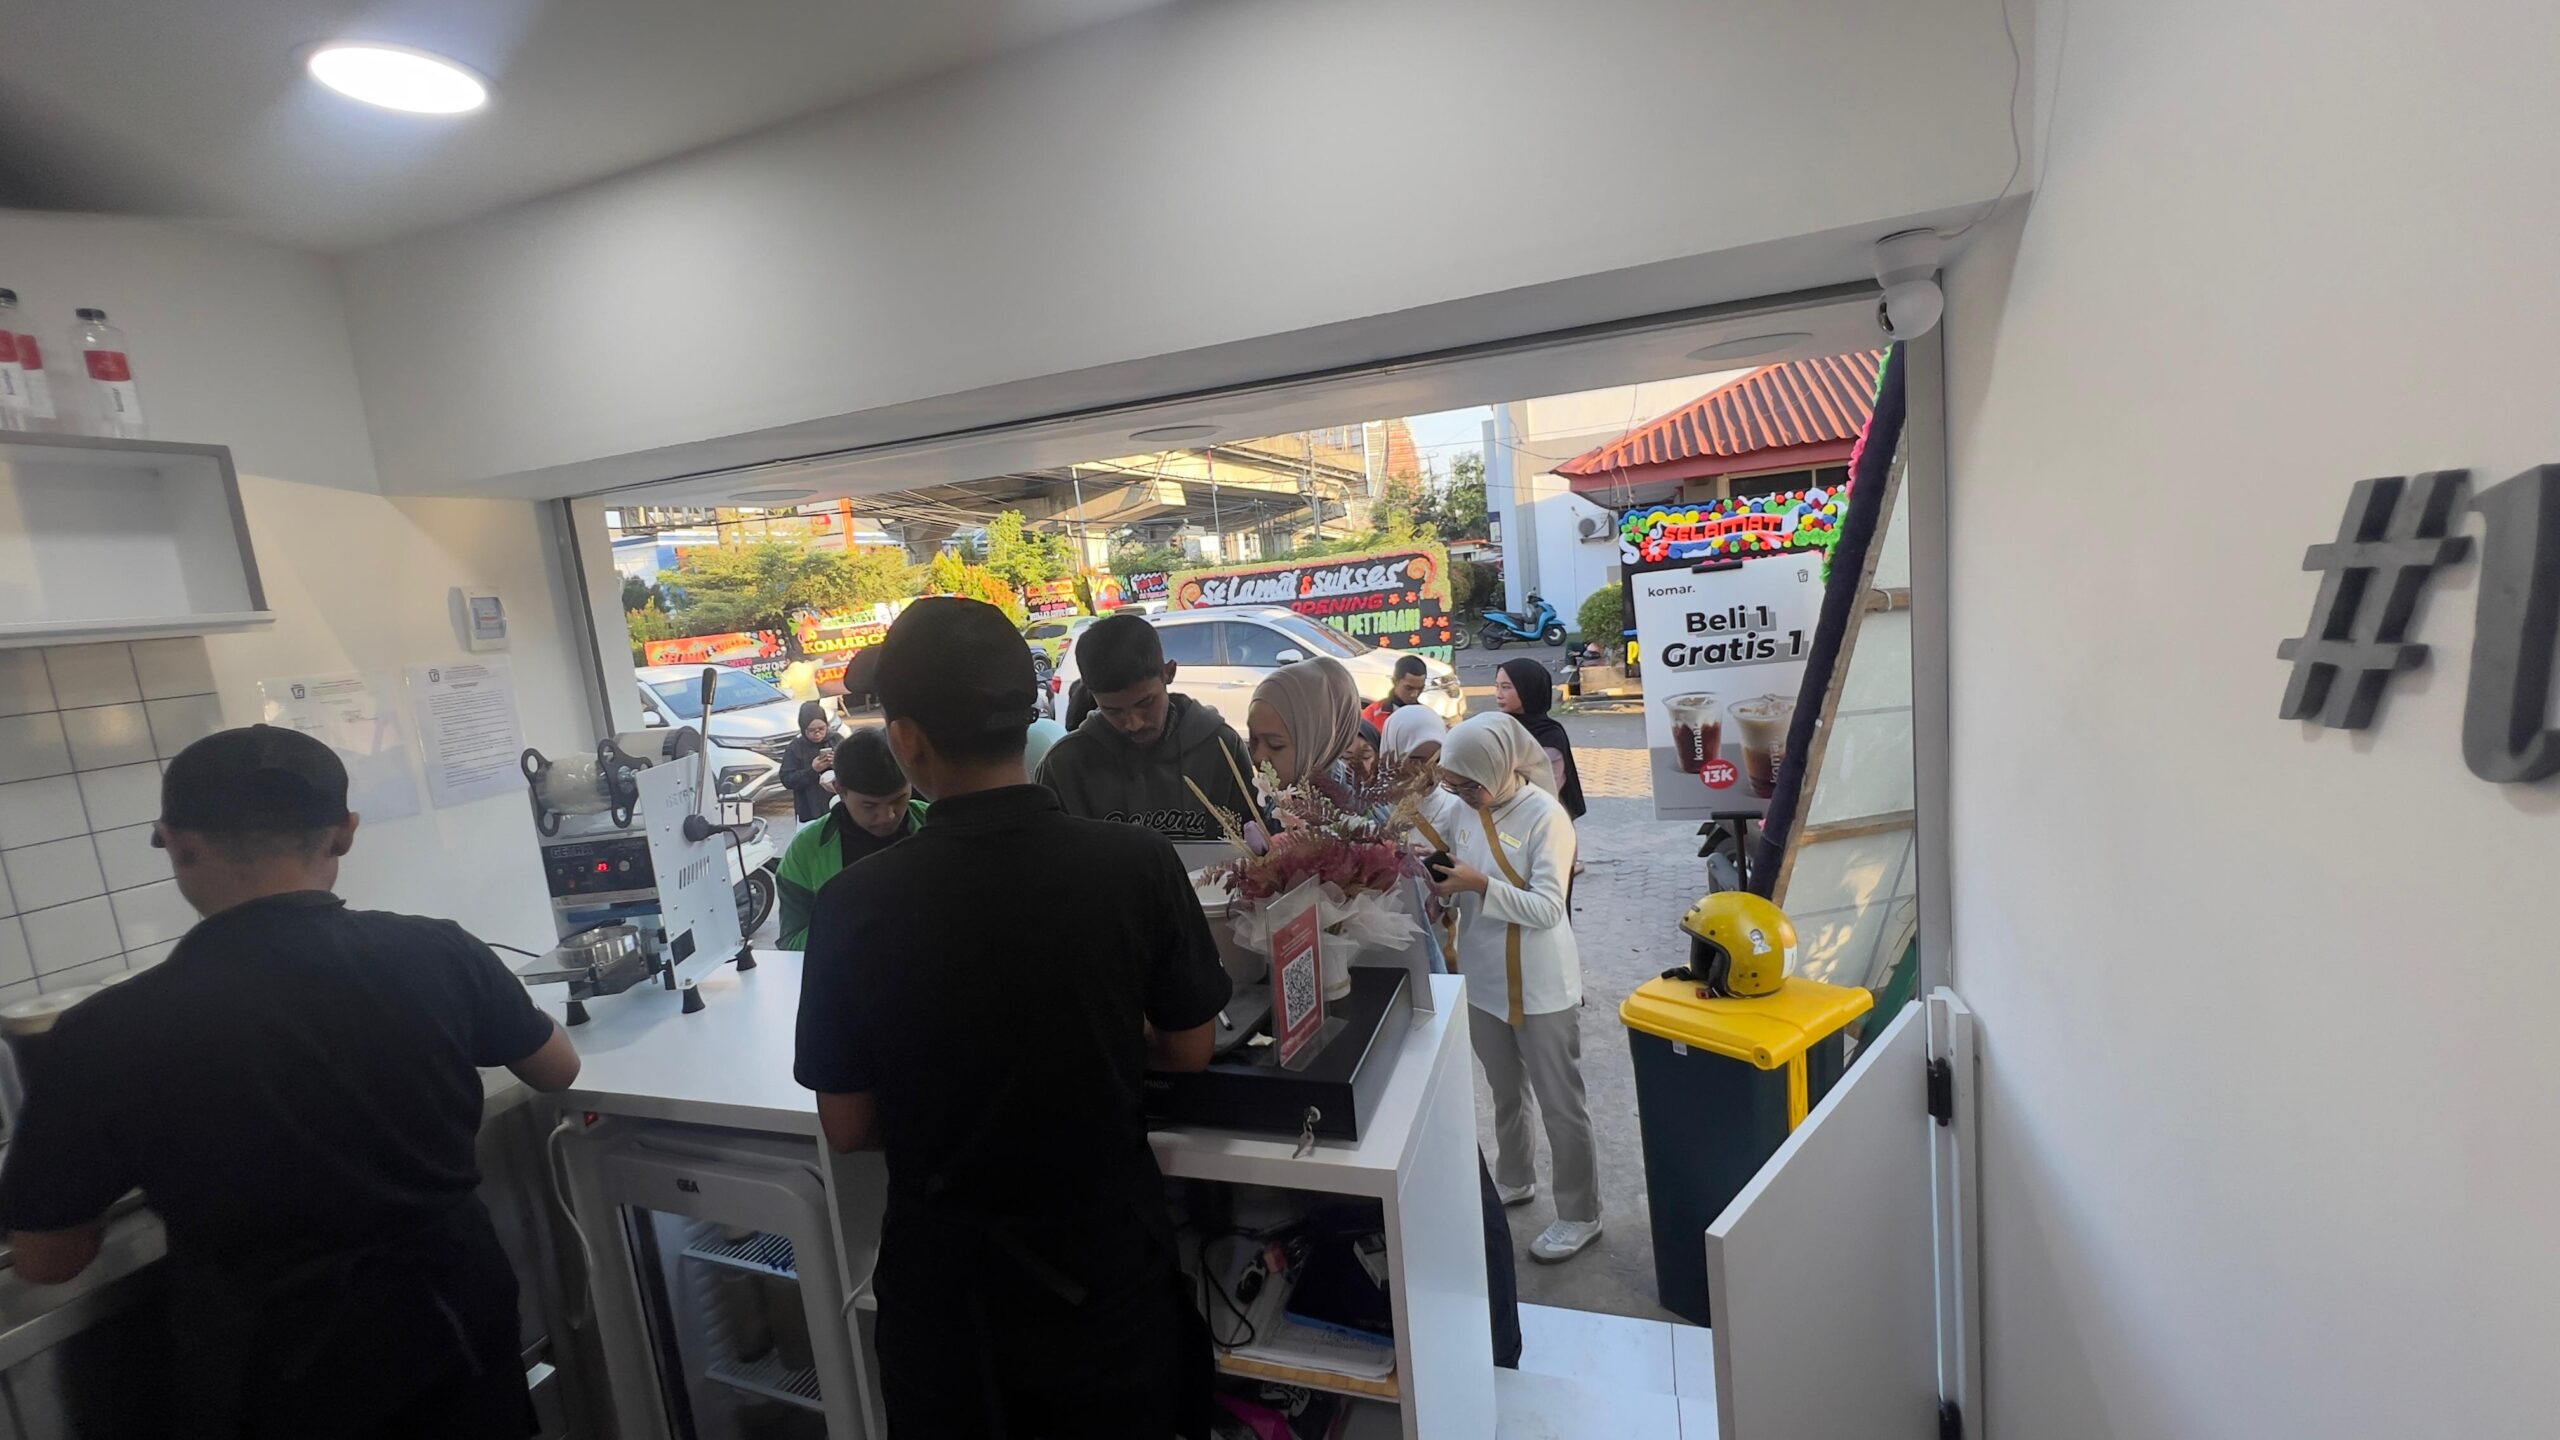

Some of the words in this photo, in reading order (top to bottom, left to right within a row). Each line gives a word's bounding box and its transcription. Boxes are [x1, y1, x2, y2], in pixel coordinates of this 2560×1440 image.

[1662, 514, 1783, 542] SELAMAT
[1648, 585, 1696, 597] komar.
[1290, 593, 1385, 615] OPENING
[1686, 605, 1747, 633] Beli
[1756, 605, 1769, 627] 1
[801, 636, 867, 654] KOMAR
[1662, 631, 1776, 668] Gratis
[1788, 630, 1803, 655] 1
[1703, 768, 1734, 783] 13K
[676, 1178, 700, 1193] GEA
